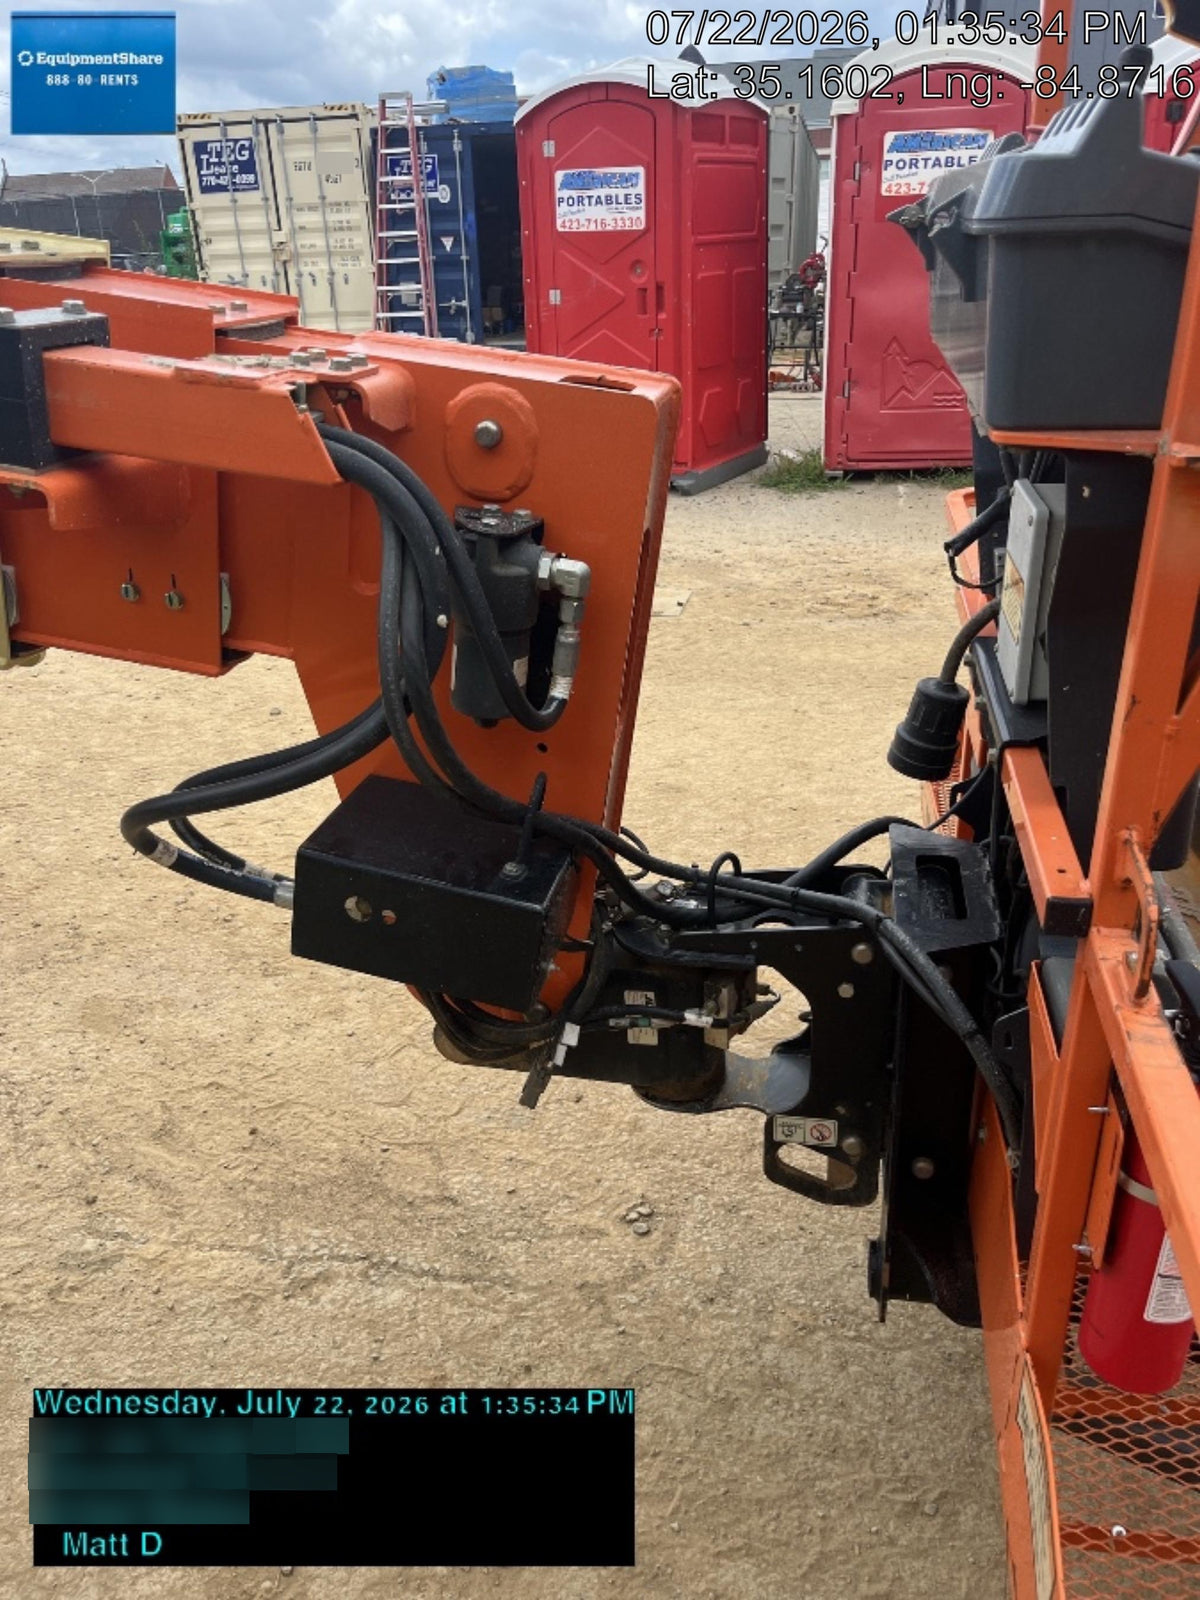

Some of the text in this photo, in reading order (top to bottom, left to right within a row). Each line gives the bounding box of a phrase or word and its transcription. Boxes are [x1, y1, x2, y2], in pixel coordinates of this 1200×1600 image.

[207, 140, 251, 163] TEG
[883, 155, 978, 171] PORTABLE
[557, 193, 643, 207] PORTABLES
[560, 216, 643, 230] 423-716-3330
